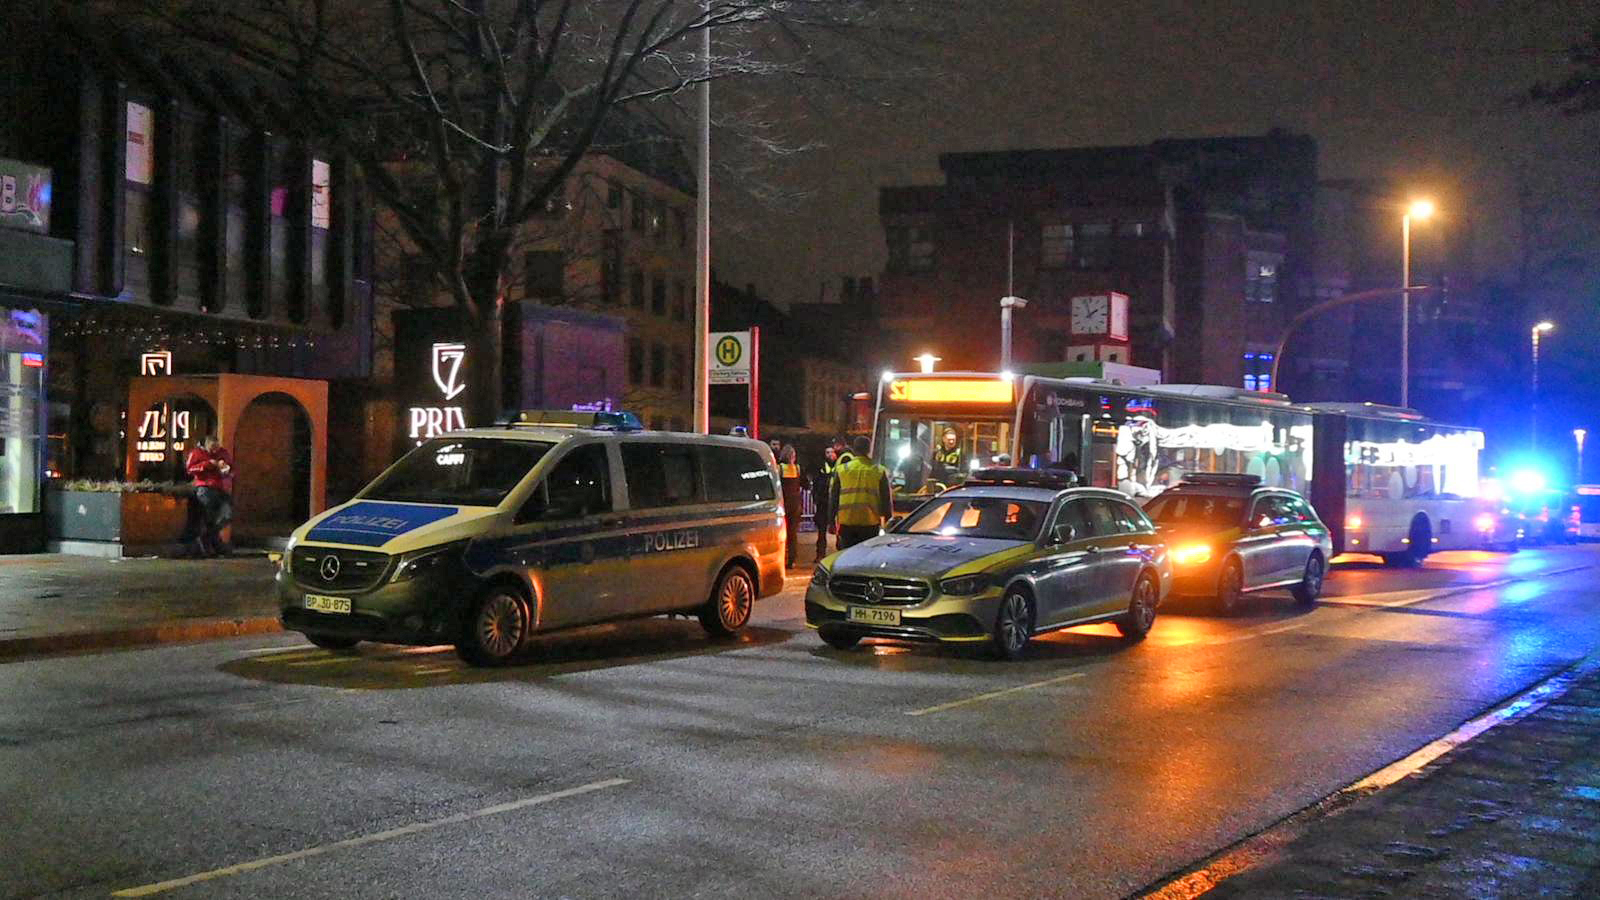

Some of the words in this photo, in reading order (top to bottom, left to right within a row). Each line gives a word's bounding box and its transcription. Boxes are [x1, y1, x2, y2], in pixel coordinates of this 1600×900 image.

[328, 515, 408, 530] POLIZEI
[645, 531, 699, 552] POLIZEI
[872, 610, 895, 622] 7196
